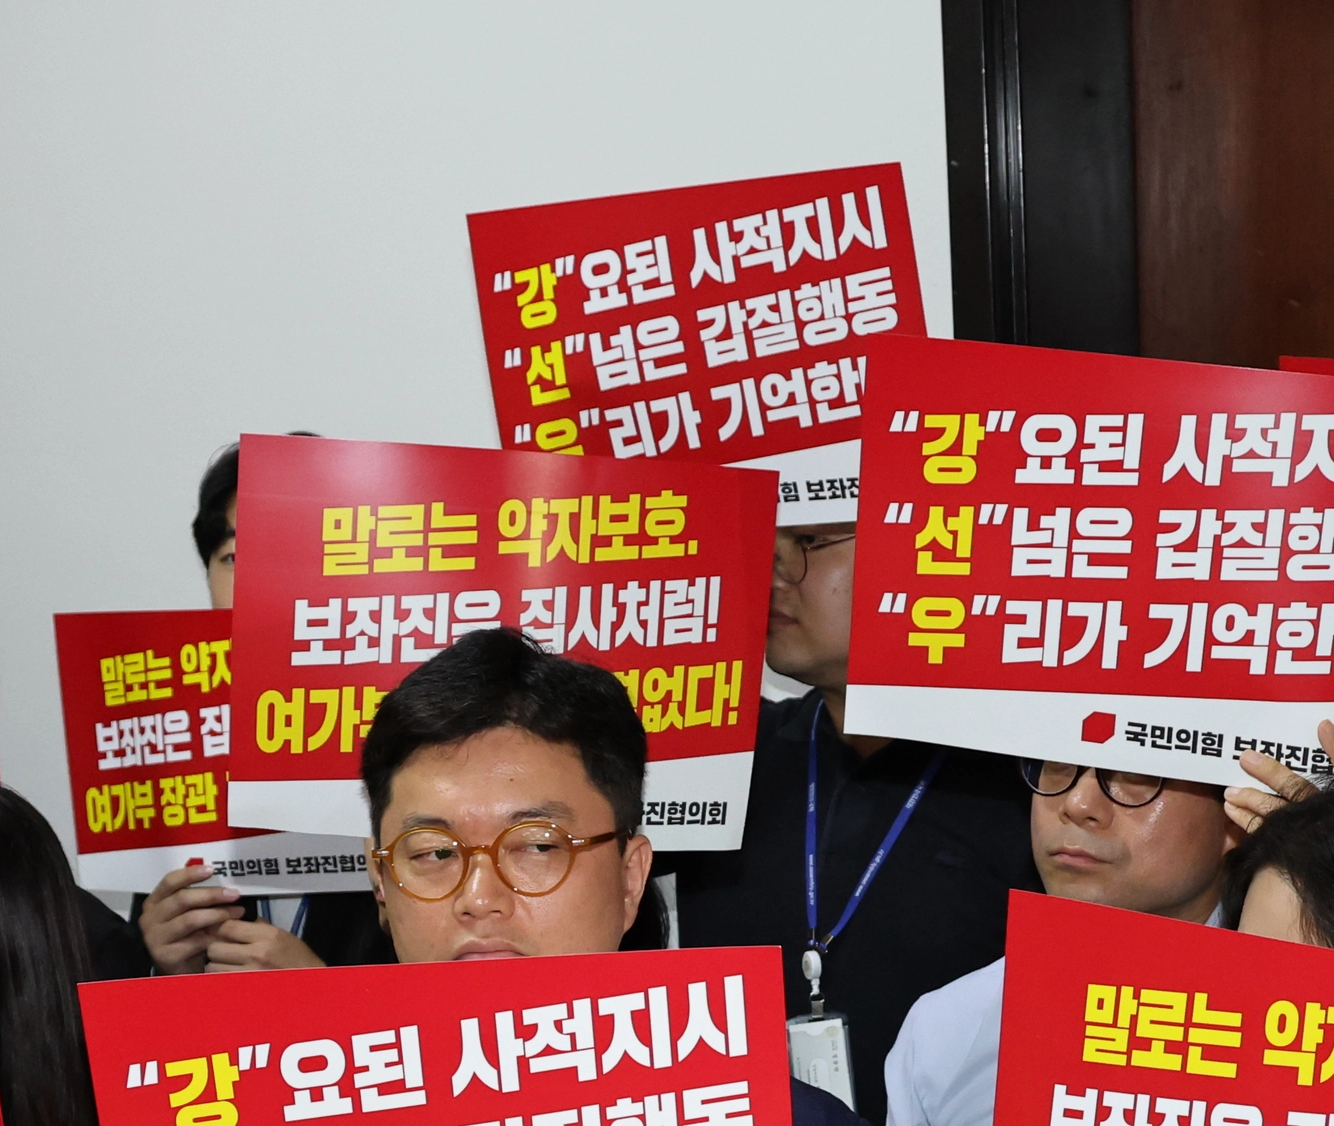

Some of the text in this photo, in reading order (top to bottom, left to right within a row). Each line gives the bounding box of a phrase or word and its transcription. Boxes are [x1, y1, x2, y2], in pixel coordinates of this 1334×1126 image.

[493, 185, 888, 330] “강”요된 사적지시
[503, 266, 899, 407] “선”넘은 갑질행동
[710, 355, 867, 443] 기억한
[888, 409, 1146, 487] “강”요된
[805, 477, 860, 501] 보좌진
[322, 489, 698, 576] 말로는 약자보호.
[882, 502, 1134, 582] “선”넘은
[520, 576, 722, 655] 집사처럼!
[877, 592, 1128, 671] “우”리가
[100, 649, 173, 707] 말로는
[615, 660, 743, 735] 없다!
[95, 709, 192, 771] 보좌진은
[1124, 721, 1224, 758] 국민의힘
[86, 771, 219, 833] 여가부 장관
[642, 801, 728, 825] 진협의회
[212, 854, 367, 877] 국민의힘 보좌진협의
[452, 974, 748, 1099] 사적지시
[1082, 983, 1243, 1079] 말로는
